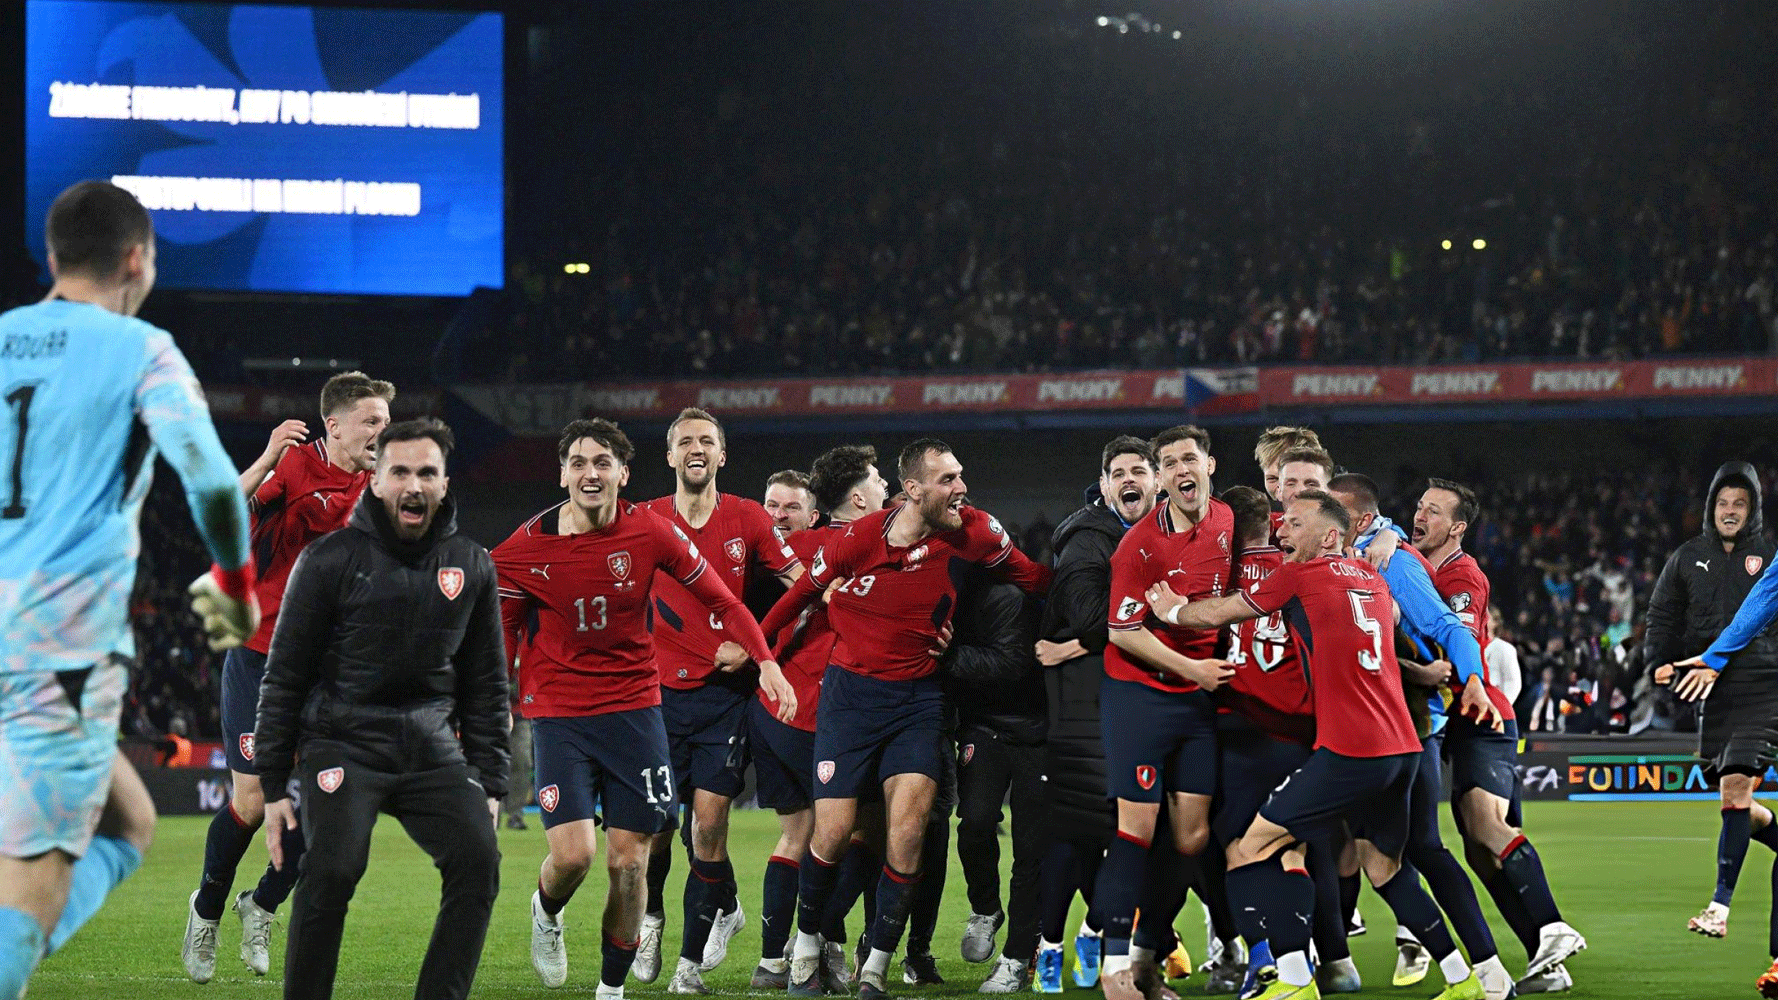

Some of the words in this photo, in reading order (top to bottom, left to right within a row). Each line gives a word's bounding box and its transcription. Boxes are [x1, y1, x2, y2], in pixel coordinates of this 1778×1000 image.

[3, 381, 36, 519] 1
[573, 595, 608, 633] 13
[1347, 588, 1383, 672] 5
[640, 764, 673, 804] 13
